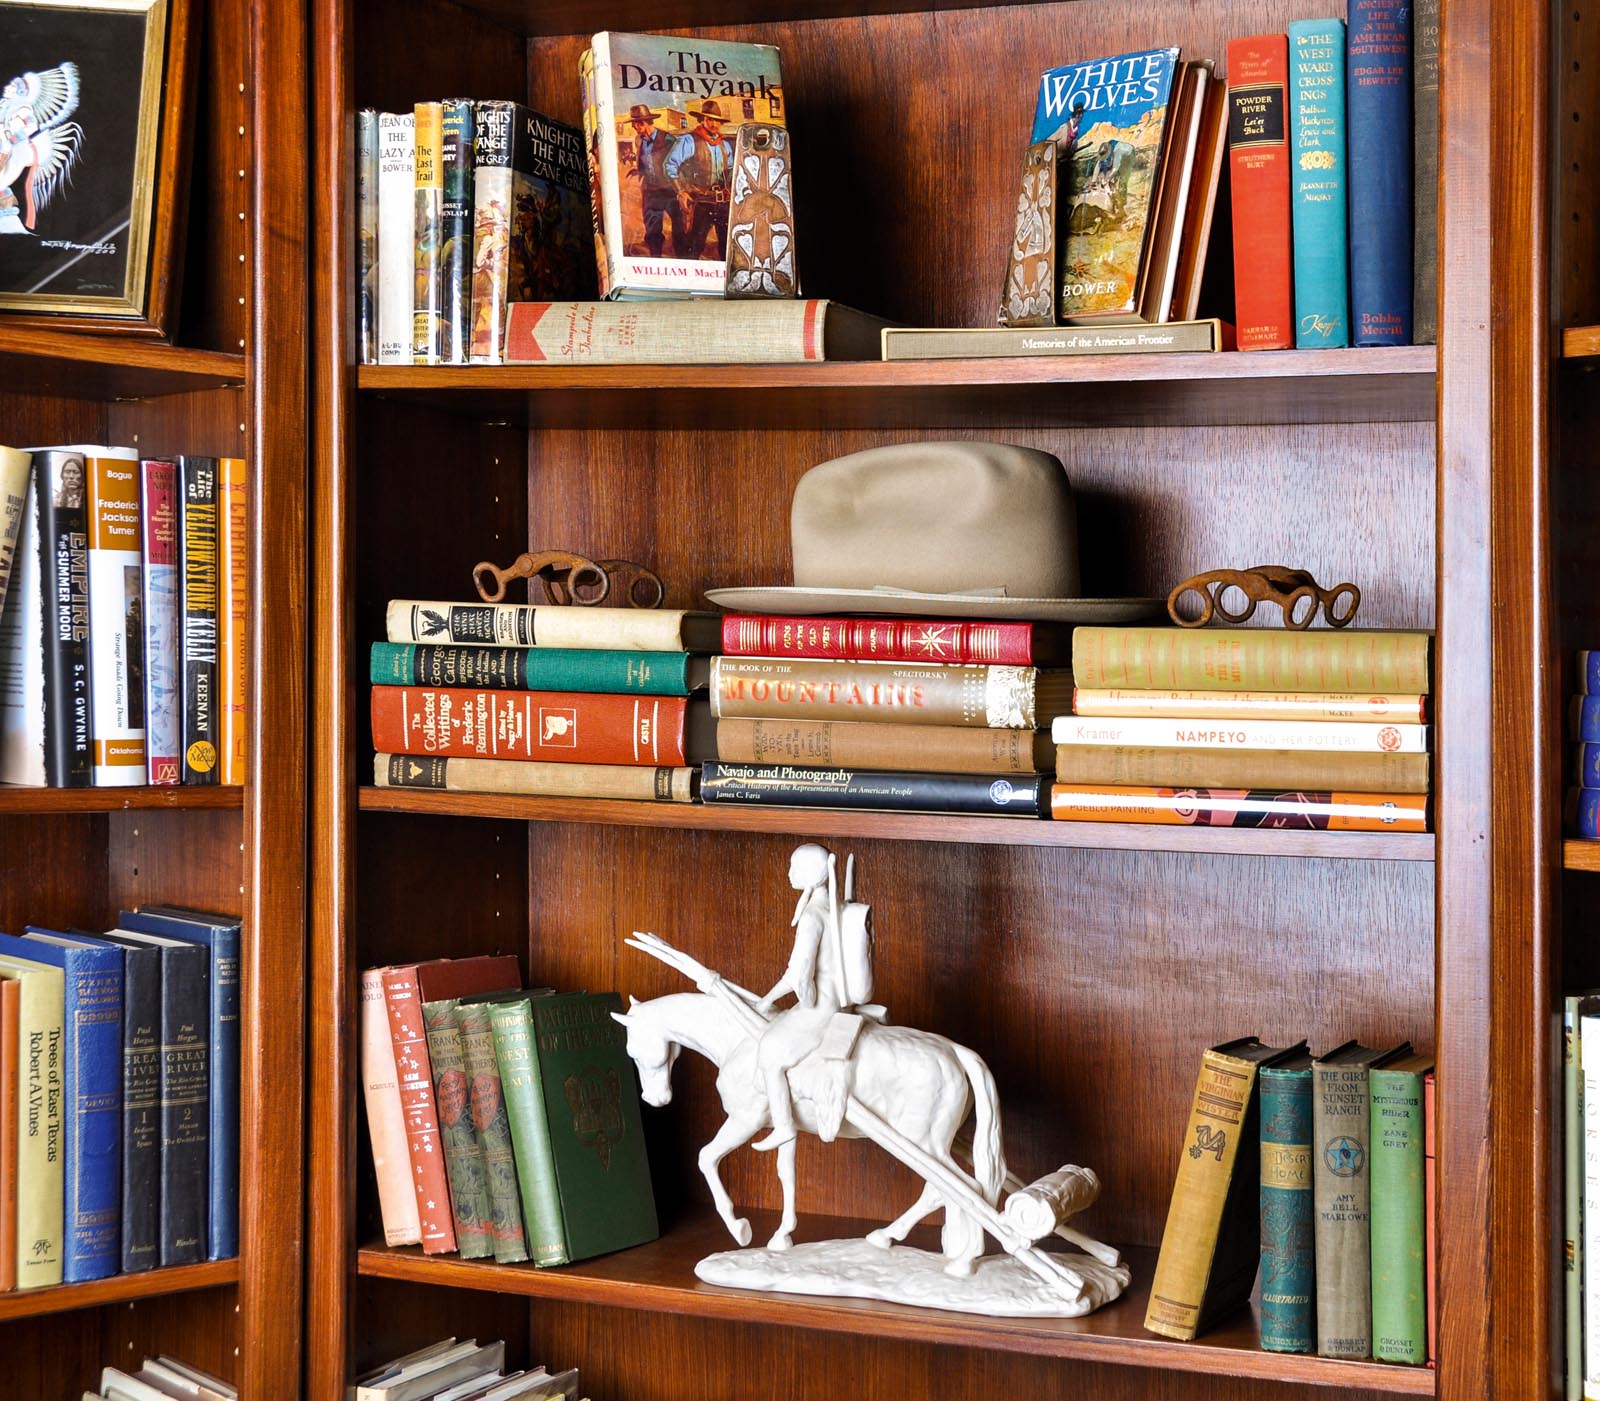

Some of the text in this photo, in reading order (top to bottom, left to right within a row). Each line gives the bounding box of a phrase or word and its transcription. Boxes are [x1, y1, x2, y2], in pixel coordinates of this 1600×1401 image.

[1356, 1, 1401, 11] ANCIENT
[1367, 12, 1390, 21] LIFE
[1376, 22, 1396, 31] THE
[1308, 35, 1333, 45] THE
[1353, 33, 1405, 44] AMERICAN
[1299, 48, 1333, 59] WEST
[1350, 44, 1409, 56] SOUTHWEST
[668, 50, 728, 76] The
[1299, 62, 1334, 73] WARD
[1353, 66, 1404, 77] EDGAR LEE
[620, 63, 776, 101] Damyank
[1358, 76, 1402, 86] HEWETT
[1236, 95, 1272, 106] POWDER
[1299, 89, 1327, 100] INGS
[1242, 104, 1267, 114] RIVER
[380, 117, 400, 128] JEAN
[488, 125, 506, 137] THE
[527, 117, 580, 152] KNIGHTS
[1243, 126, 1265, 136] Buck
[1299, 127, 1336, 137] Lewis and
[388, 133, 408, 142] THE
[1299, 137, 1321, 148] Clark
[380, 149, 404, 160] LAZY
[417, 146, 432, 156] The
[531, 138, 554, 161] THE
[416, 158, 433, 169] Last
[486, 154, 510, 164] GREY
[1246, 160, 1265, 169] BURT
[383, 163, 413, 173] BOWER
[534, 158, 561, 184] ZANE
[416, 171, 433, 182] Trail
[632, 265, 688, 278] WILLIAM
[1063, 282, 1117, 298] BOWER
[579, 306, 596, 356] Timberline
[1301, 313, 1342, 337] Knopf
[1361, 325, 1403, 336] Merrill
[561, 311, 578, 358] Stampede
[1022, 334, 1173, 350] Memories of the American Frontier
[107, 470, 133, 480] Bogue
[205, 470, 214, 499] The
[189, 483, 198, 500] of
[101, 512, 139, 524] Jackson
[107, 526, 136, 536] Turner
[70, 531, 90, 643] EMPIRE
[186, 503, 216, 664] YELLOWSTONE KELLY
[57, 551, 72, 642] SUMMER MOON
[783, 625, 792, 649] GUNS
[808, 628, 817, 646] OLD
[822, 625, 832, 649] WEST
[114, 632, 122, 660] Strange
[114, 660, 123, 682] Roads
[431, 645, 444, 686] George
[444, 649, 456, 684] Catlin
[459, 649, 468, 683] EPISODES
[466, 656, 474, 678] FROM
[720, 663, 792, 674] THE BOOK OF THE
[892, 669, 948, 681] SPECTORSKY
[115, 684, 124, 706] Going
[723, 677, 926, 708] MOUNTAINS
[75, 664, 87, 752] S. C. GWYNNE
[197, 673, 208, 732] KEENAN
[505, 699, 514, 723] Harold
[412, 712, 421, 730] The
[423, 692, 437, 752] Collected
[439, 693, 452, 750] Writings
[451, 718, 461, 728] of
[462, 700, 474, 746] Frederic
[474, 693, 488, 754] Remington
[641, 718, 651, 745] CASTLE
[1076, 726, 1123, 741] Kramer
[1175, 729, 1358, 747] NAMPEYO AND HER POTTERY
[109, 746, 144, 756] Oklahoma
[716, 765, 854, 784] Navajo and Photography
[716, 790, 761, 801] James C. Faris
[746, 783, 772, 792] History
[772, 783, 780, 792] of
[780, 784, 791, 792] the
[792, 784, 838, 795] Representation
[838, 786, 849, 794] of
[858, 787, 890, 797] American
[890, 788, 912, 798] People
[1070, 803, 1156, 815] PUEBLO PAINTING
[430, 1032, 461, 1048] FRANK
[461, 1036, 490, 1050] FRANK
[30, 1031, 44, 1081] Robert
[166, 1050, 207, 1063] GREAT
[1213, 1074, 1233, 1088] THE
[1321, 1071, 1367, 1083] THE GIRL
[1201, 1079, 1245, 1101] VIRGINIAN
[1327, 1083, 1359, 1094] FROM
[1386, 1083, 1406, 1093] THE
[47, 1027, 61, 1163] Trees of East Texas
[1322, 1093, 1365, 1105] SUNSET
[1372, 1095, 1419, 1107] MYSTERIOUS
[183, 1107, 192, 1122] 2
[1196, 1099, 1239, 1119] WISTER
[1325, 1104, 1362, 1116] RANCH
[1381, 1108, 1411, 1119] RIDER
[141, 1111, 147, 1124] 1
[1383, 1129, 1409, 1139] ZANE
[1382, 1139, 1409, 1149] GREY
[1275, 1151, 1312, 1166] DESERT
[1271, 1166, 1305, 1181] HOME
[1336, 1193, 1356, 1203] AMY
[1332, 1202, 1359, 1212] BELL
[1321, 1212, 1369, 1222] MARLOWE
[1263, 1294, 1310, 1305] ILLUSTRATED
[1327, 1337, 1367, 1346] GROSSET
[1380, 1336, 1413, 1347] GROSSET
[1334, 1345, 1367, 1354] DUNLAP
[1385, 1345, 1415, 1355] DUNLAP
